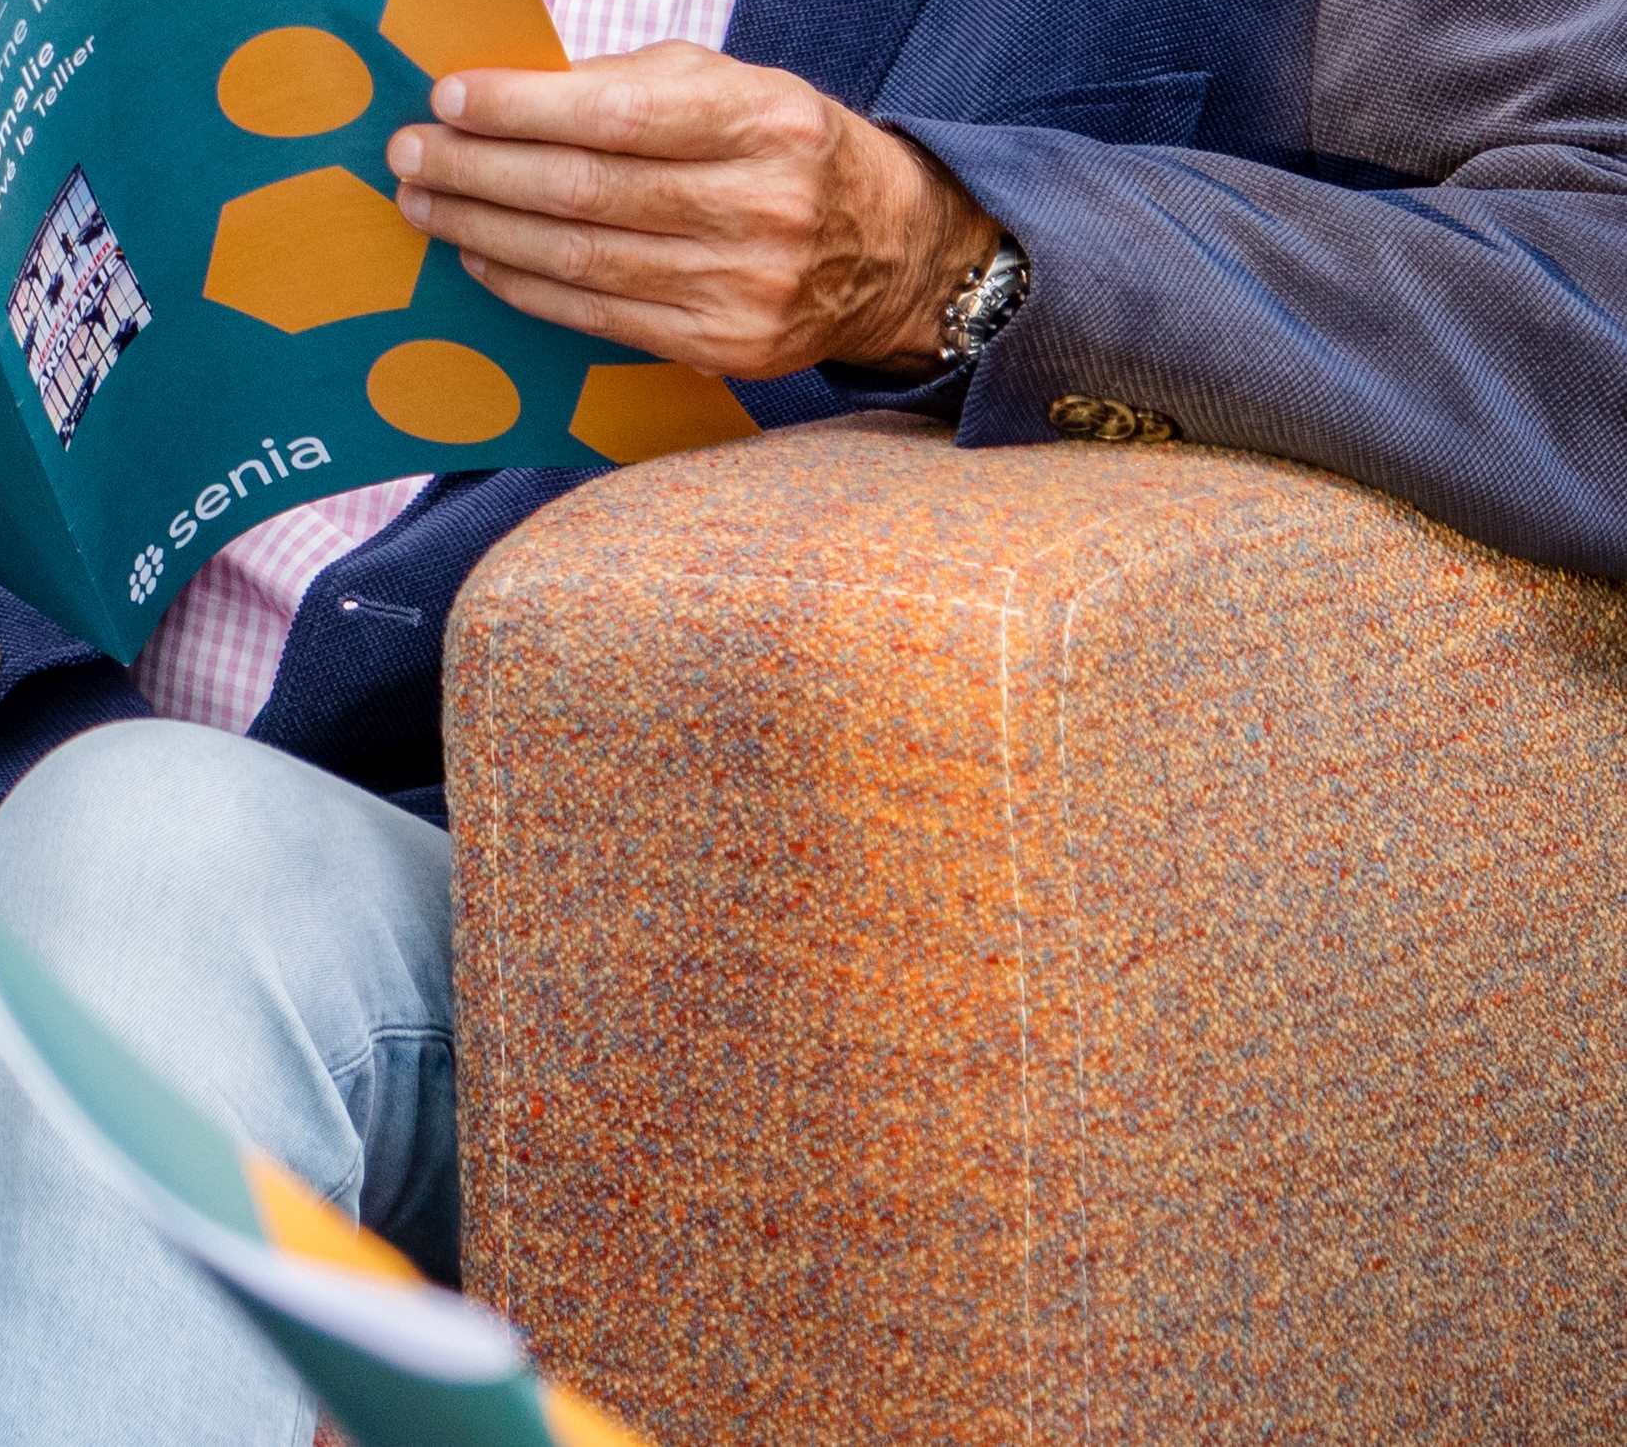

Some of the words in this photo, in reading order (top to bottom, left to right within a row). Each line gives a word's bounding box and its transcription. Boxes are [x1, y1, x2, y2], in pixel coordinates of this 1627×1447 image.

[15, 125, 34, 157] le
[33, 34, 96, 119] Tellier
[37, 253, 122, 397] ANOMALIE
[72, 240, 112, 298] TELLIER
[168, 435, 332, 549] senia
